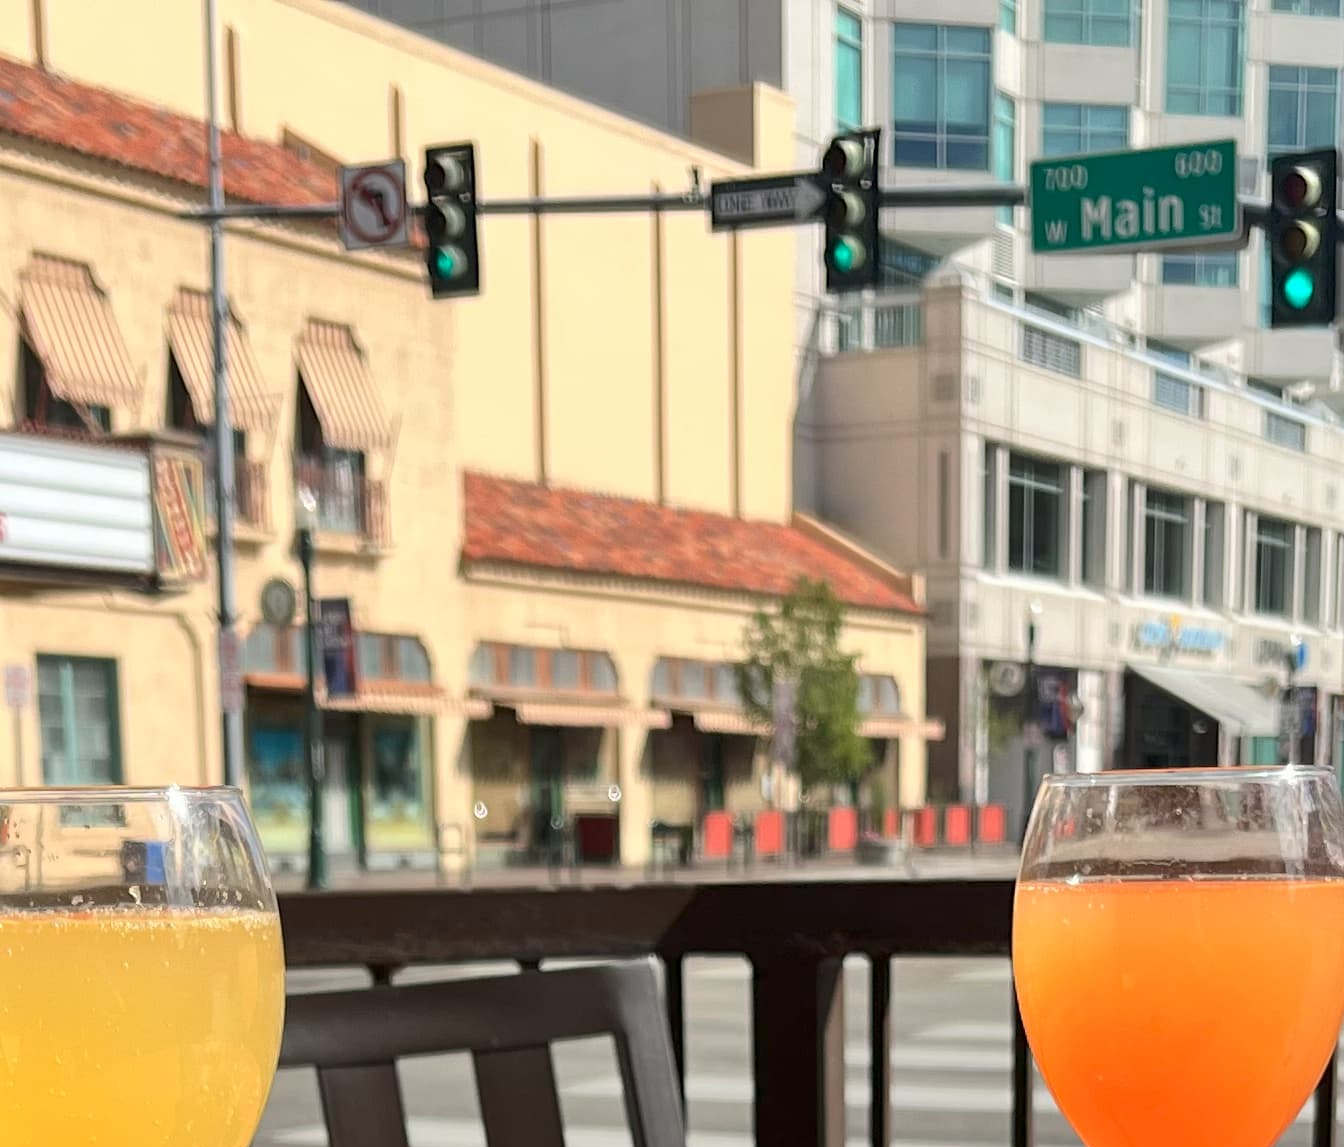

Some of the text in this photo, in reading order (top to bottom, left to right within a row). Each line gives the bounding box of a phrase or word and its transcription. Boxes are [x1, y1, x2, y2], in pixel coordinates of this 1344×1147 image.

[1043, 165, 1088, 191] 700
[1175, 149, 1223, 178] 600
[1044, 219, 1068, 244] W
[1081, 186, 1184, 241] Main
